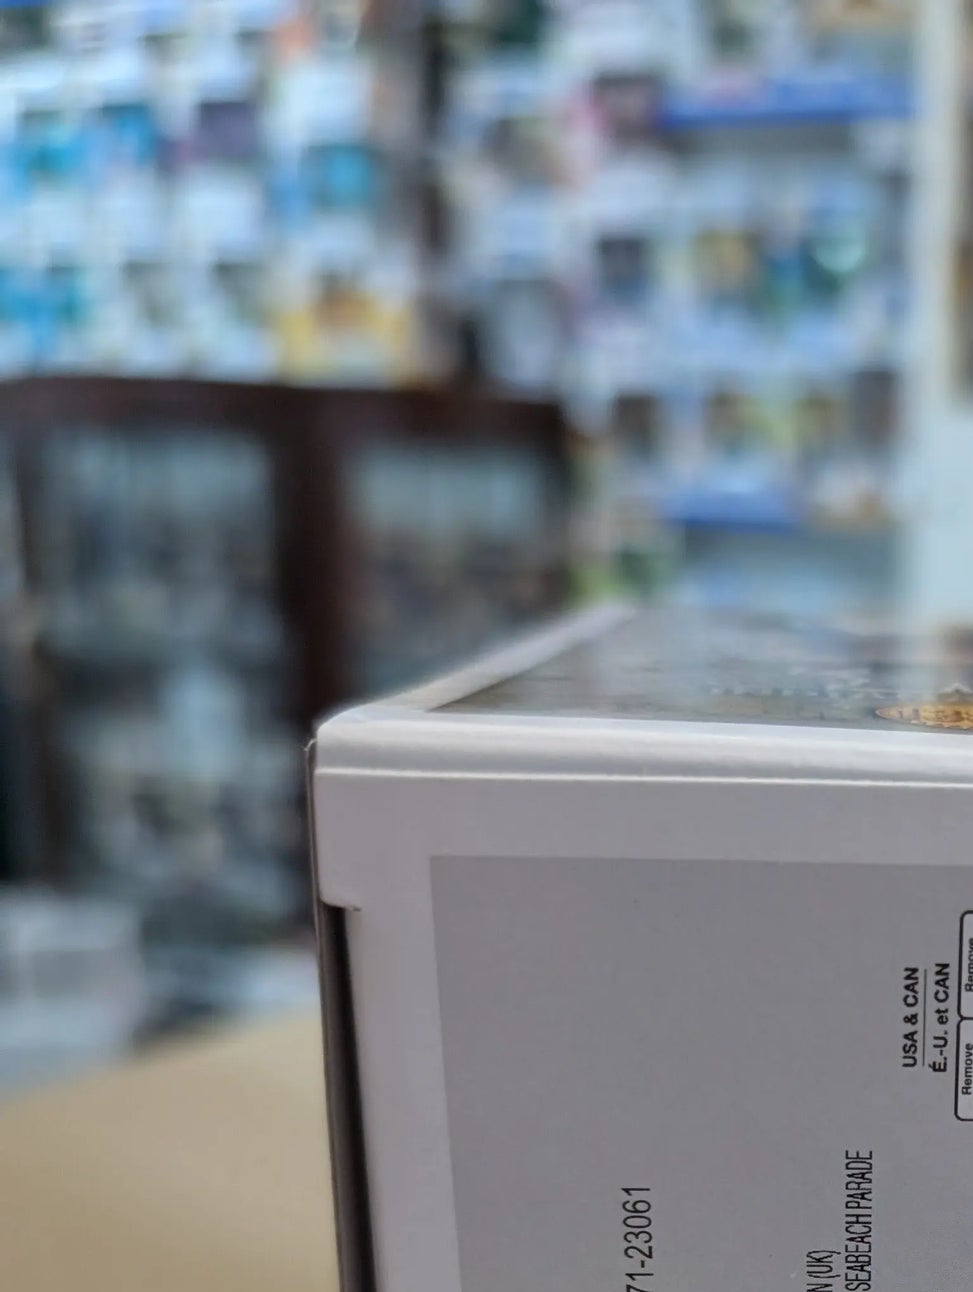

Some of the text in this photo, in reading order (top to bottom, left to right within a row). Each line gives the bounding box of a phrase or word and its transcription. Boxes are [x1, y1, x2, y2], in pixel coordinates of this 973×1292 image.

[902, 967, 919, 1068] USA & CAN
[928, 962, 950, 1073] É.-U. et CAN
[961, 1043, 973, 1095] Remove
[845, 1150, 873, 1210] PARADE
[806, 1250, 840, 1278] (UK)
[844, 1214, 872, 1292] SEABEACH
